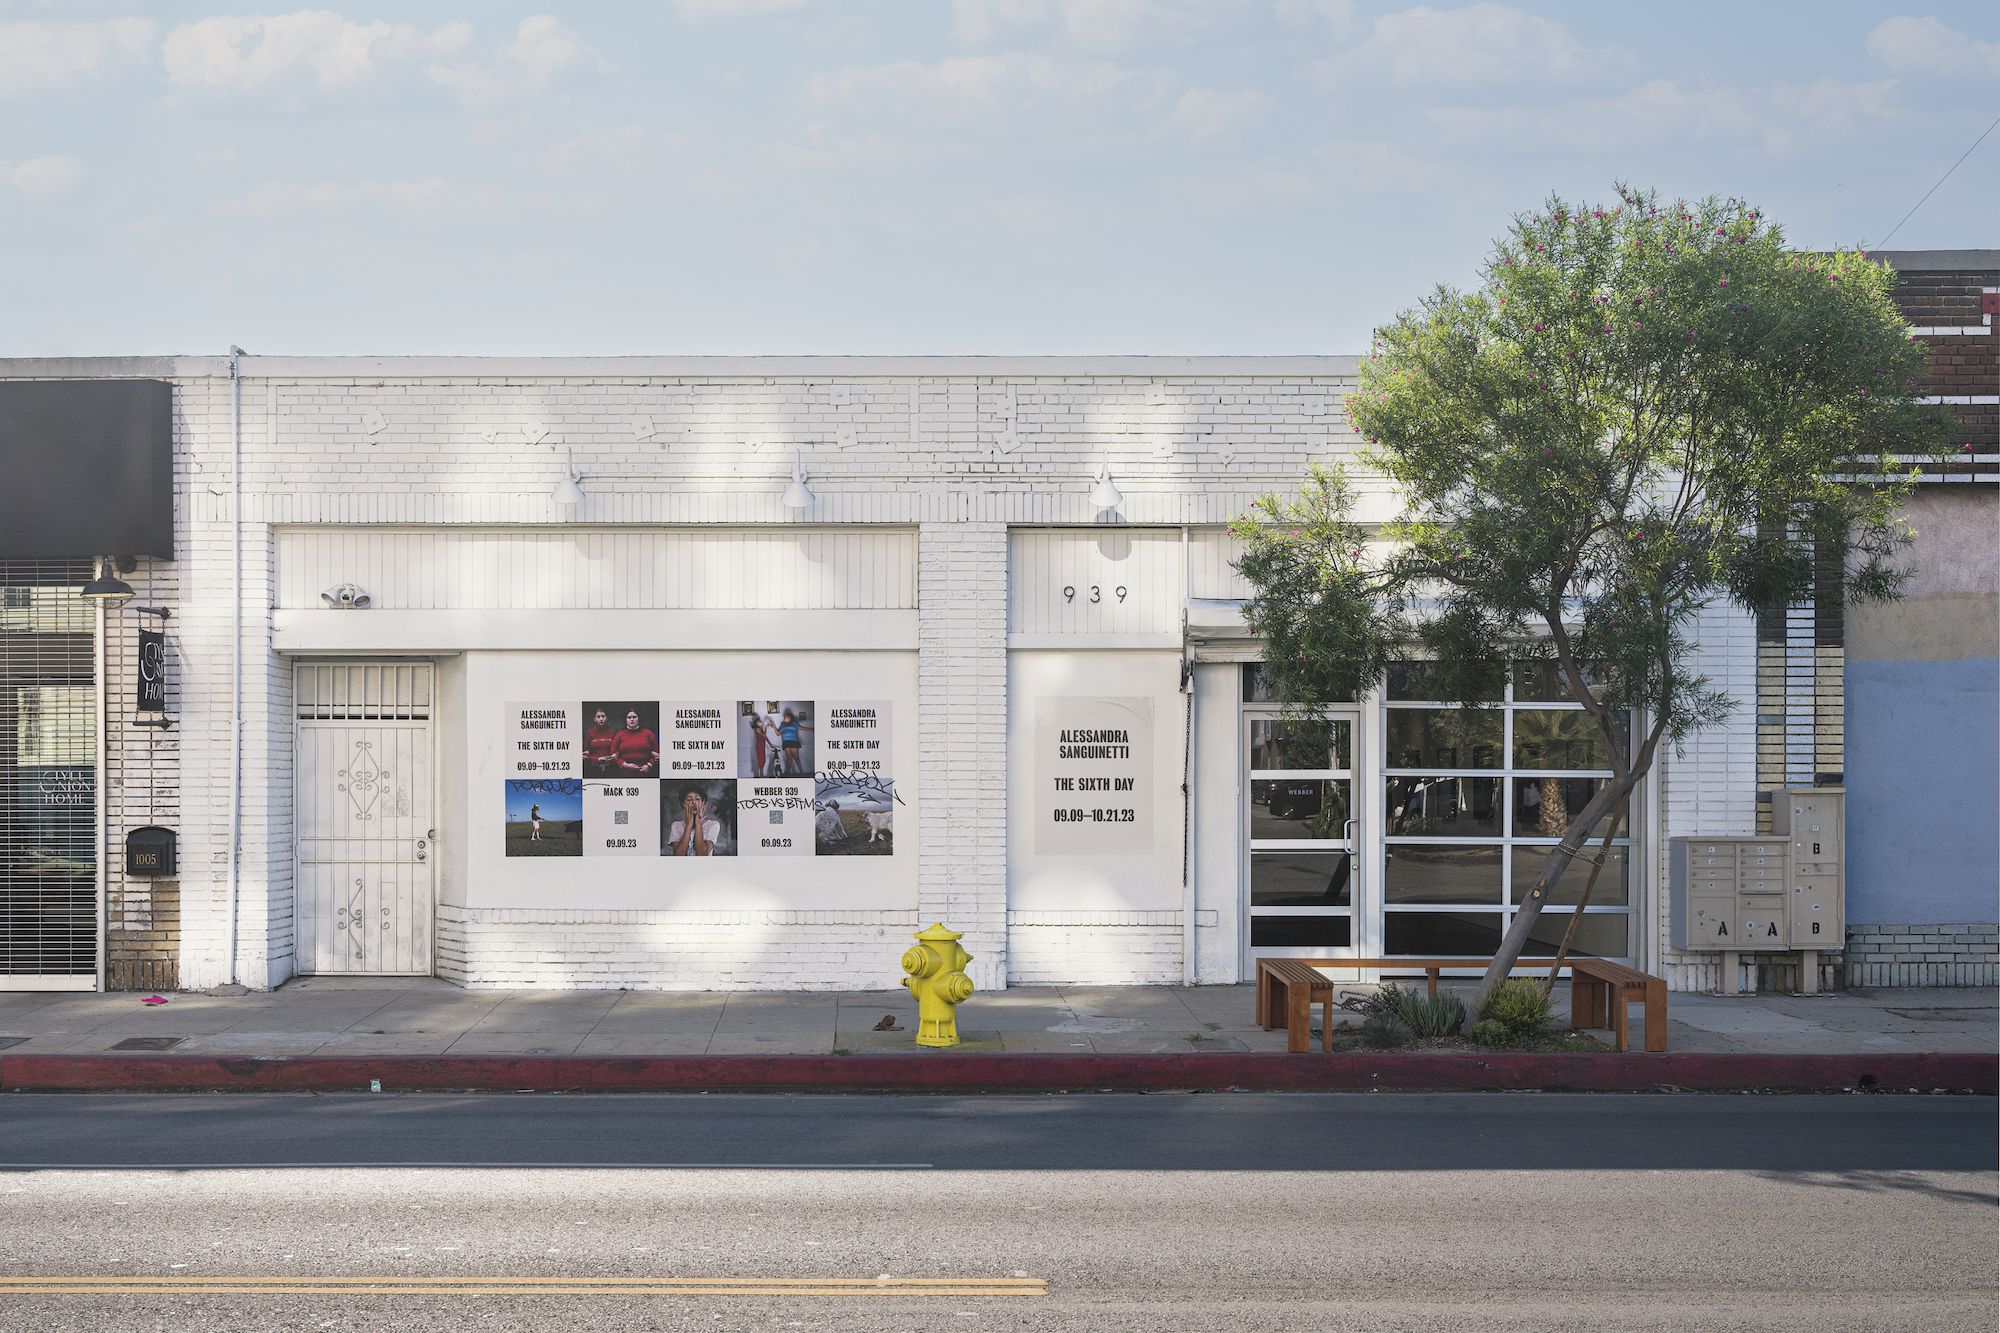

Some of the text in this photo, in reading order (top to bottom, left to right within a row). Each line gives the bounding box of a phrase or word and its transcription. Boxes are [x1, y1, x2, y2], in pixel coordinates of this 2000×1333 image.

[1063, 585, 1127, 604] 939
[520, 709, 566, 720] ALESSANDRA
[675, 709, 721, 719] ALESSANDRA
[830, 708, 877, 719] ALESSANDRA
[520, 720, 567, 730] SANGUINETTI
[675, 719, 722, 729] SANGUINETTI
[830, 718, 877, 729] SANGUINETTI
[1059, 729, 1129, 743] ALESSANDRA
[516, 741, 570, 751] THE SIXTH DAY
[672, 740, 725, 750] THE SIXTH DAY
[826, 740, 880, 750] THE SIXTH DAY
[1059, 745, 1129, 759] SANGUINETTI
[1053, 777, 1135, 792] THE SIXTH DAY
[603, 787, 640, 797] MACK 939
[754, 786, 799, 796] WEBBER 939
[606, 838, 637, 848] 09.09.23
[761, 838, 792, 848] 09.09.23
[1812, 842, 1821, 855] B
[135, 853, 157, 865] 1005
[1717, 921, 1729, 936] A
[1767, 921, 1778, 937] A
[1812, 921, 1820, 935] B
